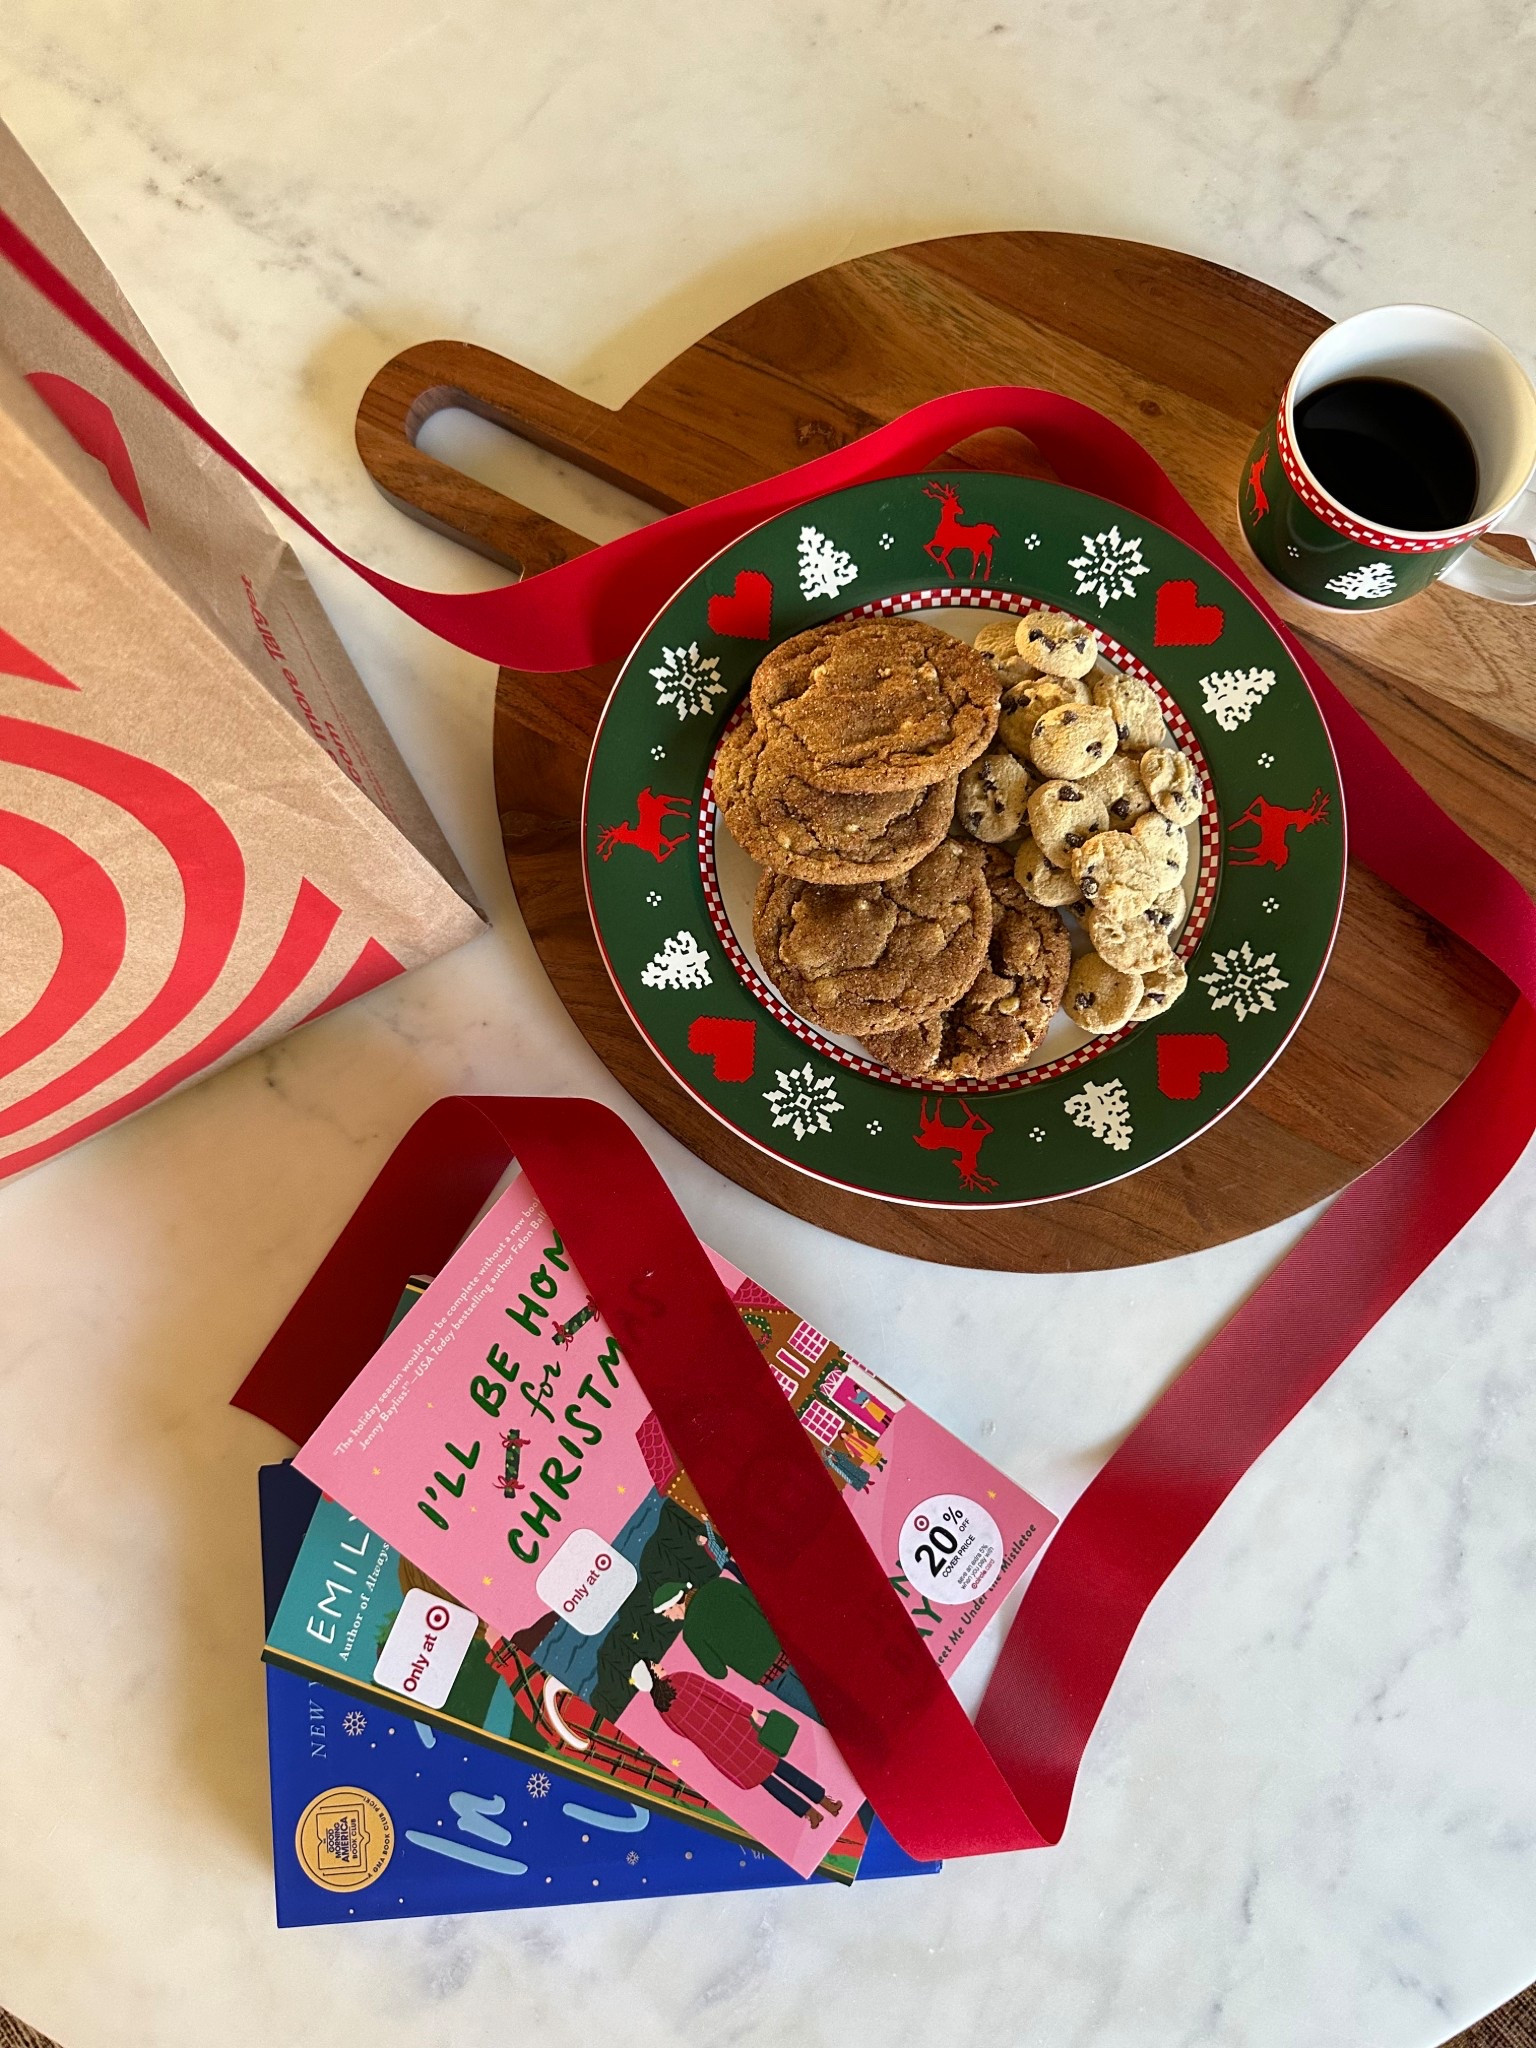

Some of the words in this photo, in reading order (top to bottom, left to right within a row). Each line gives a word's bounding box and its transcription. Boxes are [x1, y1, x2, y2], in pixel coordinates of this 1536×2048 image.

[240, 574, 286, 661] Target
[282, 667, 328, 742] more
[349, 1403, 381, 1436] holiday
[378, 1373, 403, 1403] season
[401, 1343, 425, 1372] would
[423, 1329, 438, 1346] not
[433, 1317, 447, 1329] be
[446, 1276, 480, 1317] complete
[478, 1242, 506, 1275] without
[509, 1217, 525, 1236] new
[359, 1422, 384, 1451] Jenny
[430, 1329, 455, 1355] Today
[450, 1283, 494, 1330] bestselling
[490, 1254, 513, 1284] author
[510, 1230, 533, 1254] Falon
[528, 1210, 547, 1230] Ball
[417, 1440, 480, 1531] I'LL
[469, 1343, 520, 1418] BE
[505, 1225, 570, 1337] HOM
[519, 1361, 561, 1424] for
[958, 1517, 970, 1532] OFF
[306, 1515, 370, 1644] EMIL
[942, 1555, 960, 1578] COVER
[957, 1534, 975, 1556] PRICE
[948, 1626, 965, 1646] Me
[960, 1593, 988, 1625] Under
[1001, 1524, 1036, 1573] Mistletoe
[971, 1566, 980, 1578] you
[338, 1612, 363, 1662] Author
[360, 1592, 370, 1610] of
[365, 1542, 389, 1592] Always
[563, 1583, 589, 1613] Only
[586, 1570, 600, 1586] at
[403, 1653, 429, 1692] Only
[423, 1633, 437, 1652] at
[308, 1699, 327, 1758] NEW
[363, 1796, 380, 1812] PICK!
[378, 1812, 389, 1831] CLUB
[333, 1822, 342, 1858] MORNING
[339, 1816, 350, 1863] AMERICA
[372, 1857, 385, 1873] GMA
[381, 1833, 390, 1855] BOOK
